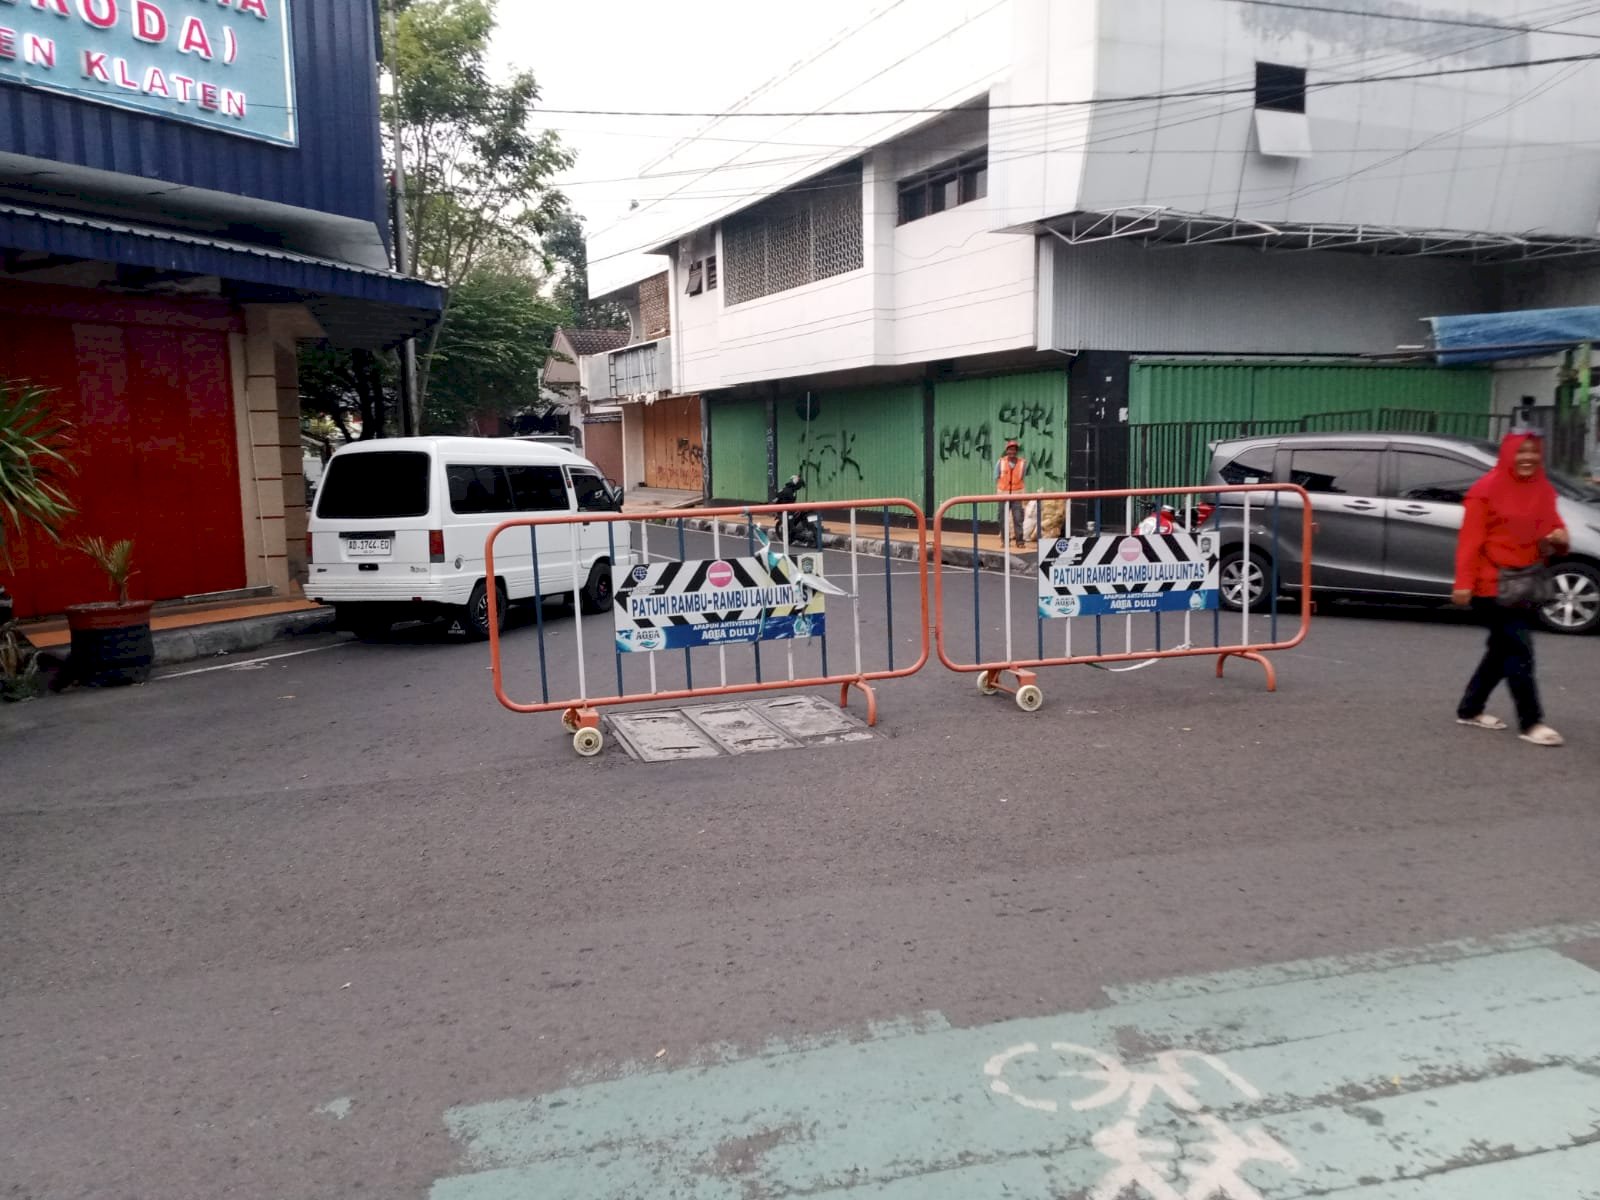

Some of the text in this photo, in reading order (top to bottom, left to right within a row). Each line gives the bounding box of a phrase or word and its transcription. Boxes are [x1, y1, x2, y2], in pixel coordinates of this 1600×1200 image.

[80, 49, 247, 119] KLATEN
[1053, 562, 1205, 585] PATUHI RAMBU-RAMBU LALU LINTAS
[632, 595, 669, 617] PATUHI
[671, 590, 748, 614] RAMBU-RAMBU
[775, 585, 809, 605] LINTS
[1110, 599, 1157, 610] AQUA DULU
[636, 629, 661, 641] AQUA
[701, 627, 756, 640] AQUA DULU
